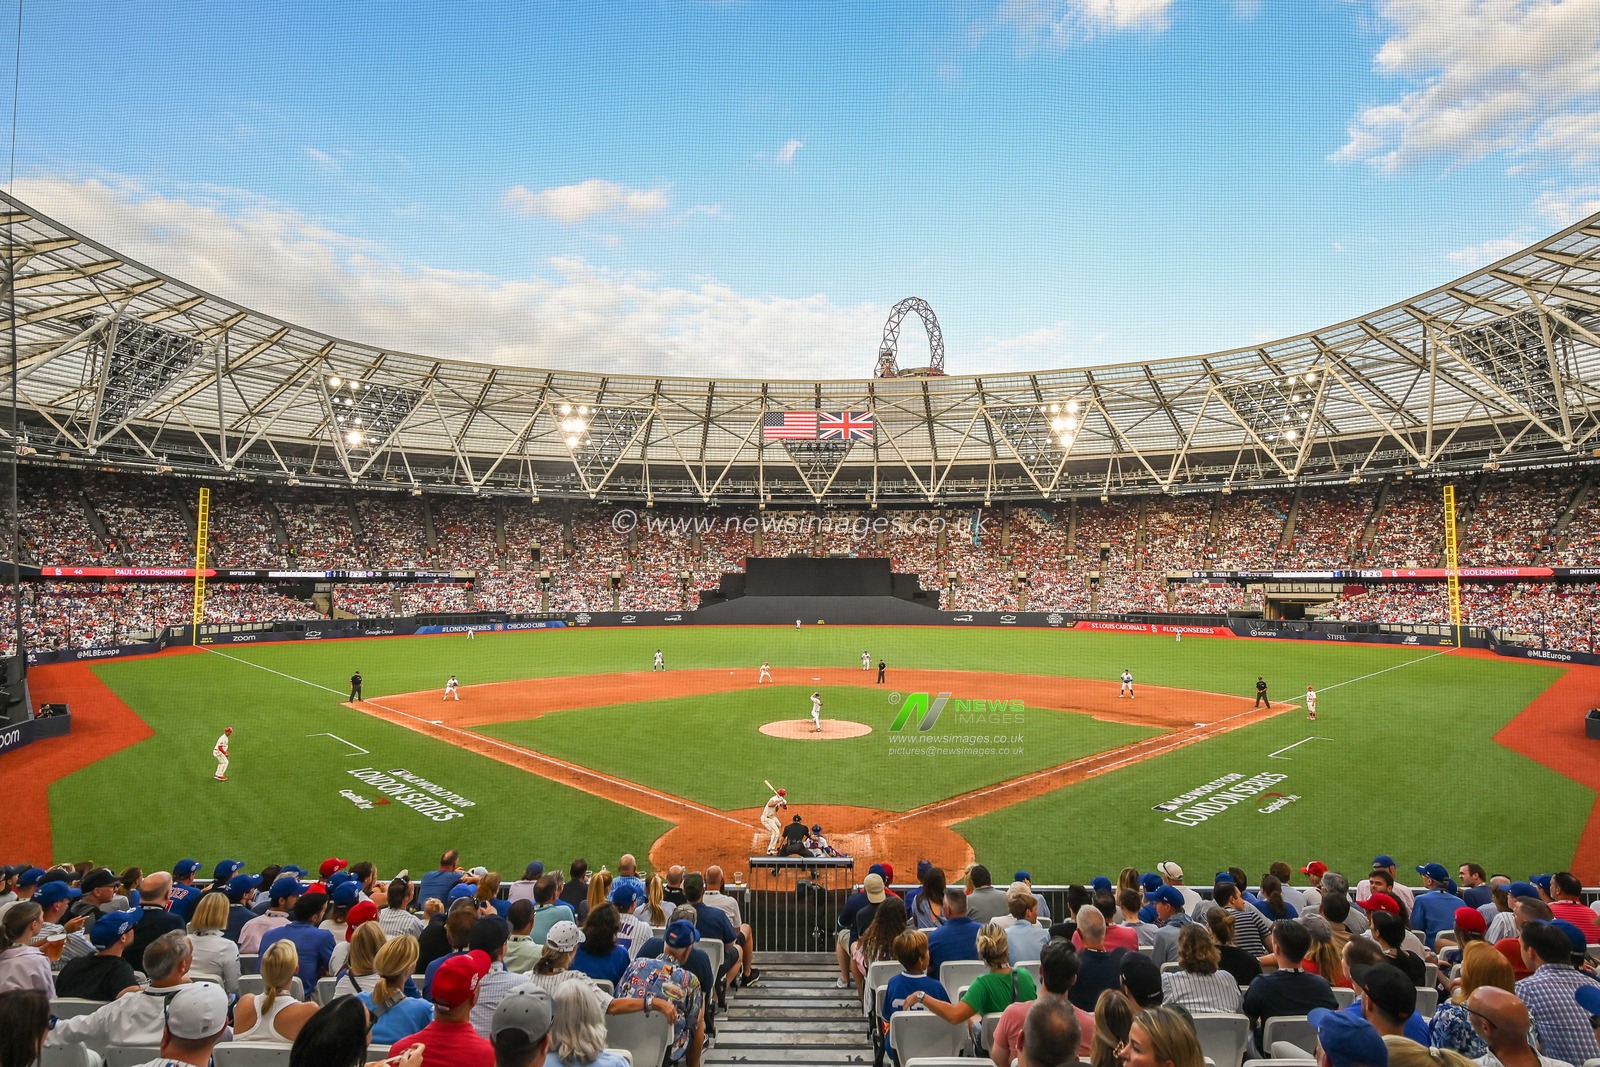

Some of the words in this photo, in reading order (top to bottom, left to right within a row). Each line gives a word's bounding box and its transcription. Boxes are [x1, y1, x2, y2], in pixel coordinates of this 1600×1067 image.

[232, 634, 256, 642] zoom
[77, 648, 120, 659] @MLBEurope
[1527, 650, 1572, 661] @MLBEurope
[346, 767, 418, 796] LONDON
[395, 792, 465, 822] SERIES
[1163, 791, 1251, 827] LONDON
[1228, 771, 1289, 795] SERIES
